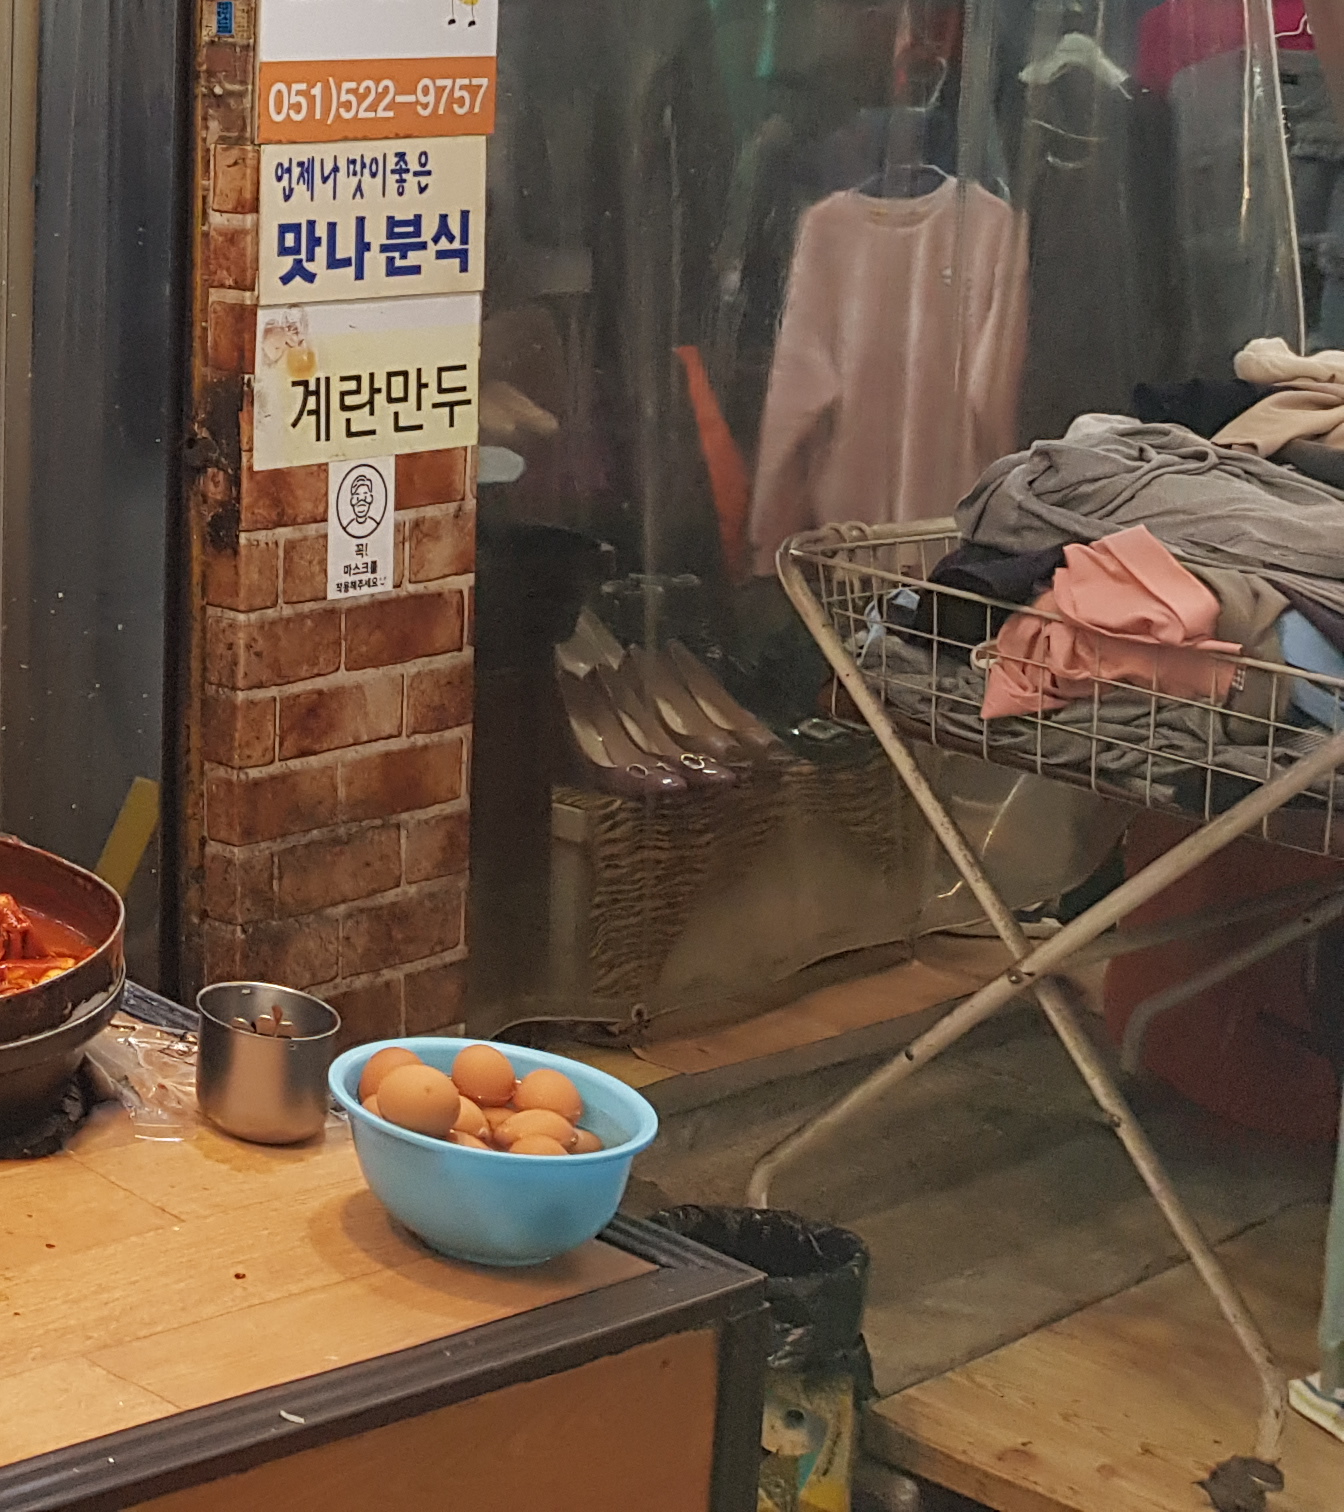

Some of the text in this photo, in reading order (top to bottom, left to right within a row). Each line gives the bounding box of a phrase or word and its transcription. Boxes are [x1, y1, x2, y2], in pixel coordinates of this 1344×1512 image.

[267, 76, 489, 124] 051)522-9757
[274, 155, 340, 202] 언제나
[289, 363, 473, 443] 계란만두
[343, 559, 378, 577] 마스크를
[354, 542, 369, 559] 꼭!
